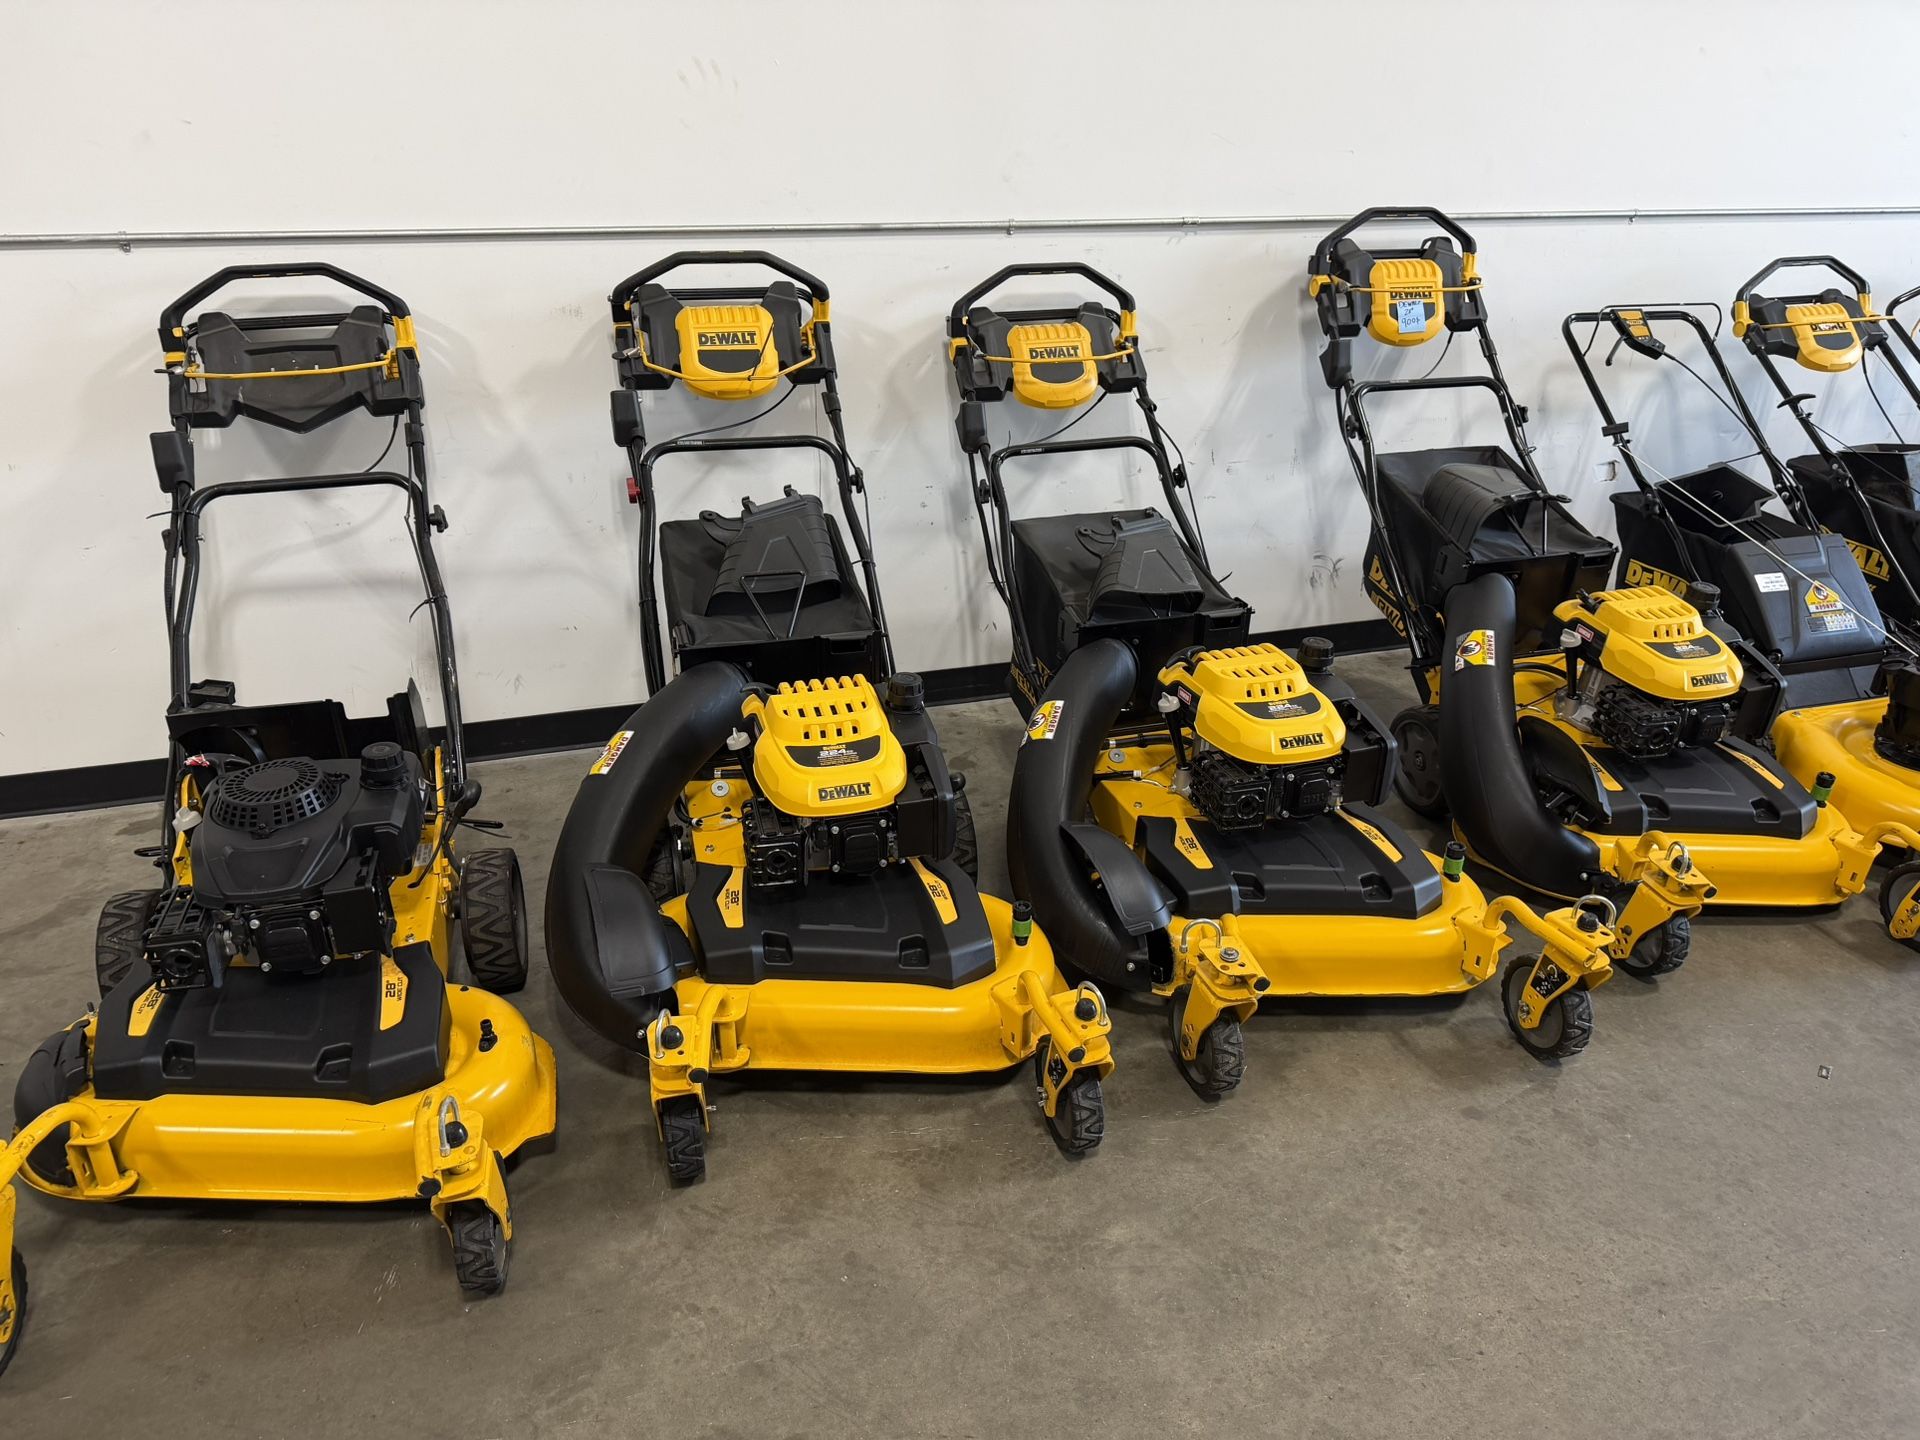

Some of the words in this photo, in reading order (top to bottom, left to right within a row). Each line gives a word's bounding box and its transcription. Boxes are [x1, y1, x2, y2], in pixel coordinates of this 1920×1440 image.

[698, 331, 757, 346] DEWALT
[1029, 346, 1080, 359] DEWALT
[1625, 560, 1688, 599] DEWA
[1486, 635, 1494, 660] DANGER
[1691, 673, 1728, 687] DEWALT
[1047, 706, 1061, 733] DANGER
[1280, 733, 1325, 750] DEWALT
[603, 737, 629, 768] DANGER
[818, 782, 872, 801] DEWALT
